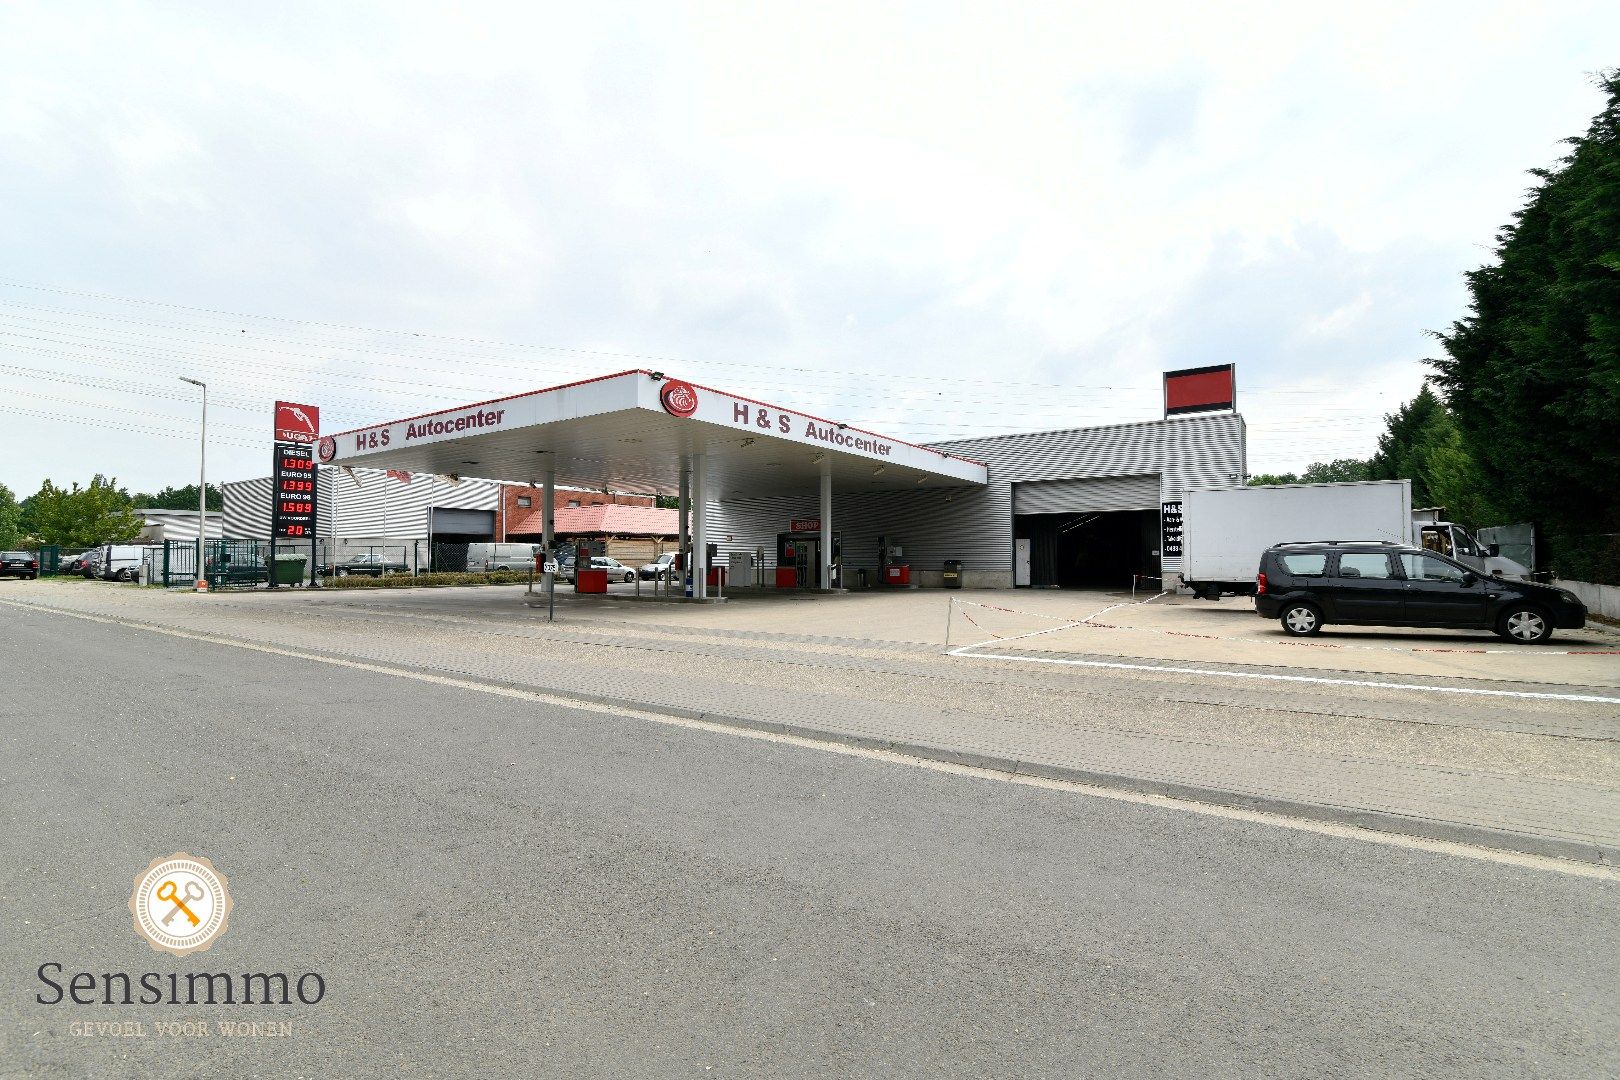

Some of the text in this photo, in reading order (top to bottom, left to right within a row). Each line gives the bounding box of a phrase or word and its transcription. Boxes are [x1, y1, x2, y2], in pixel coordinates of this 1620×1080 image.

[405, 409, 505, 440] Autocenter
[734, 402, 892, 456] H & S Autocenter
[283, 449, 310, 458] DIESEL
[281, 471, 302, 479] EURO
[795, 521, 819, 530] SHOP
